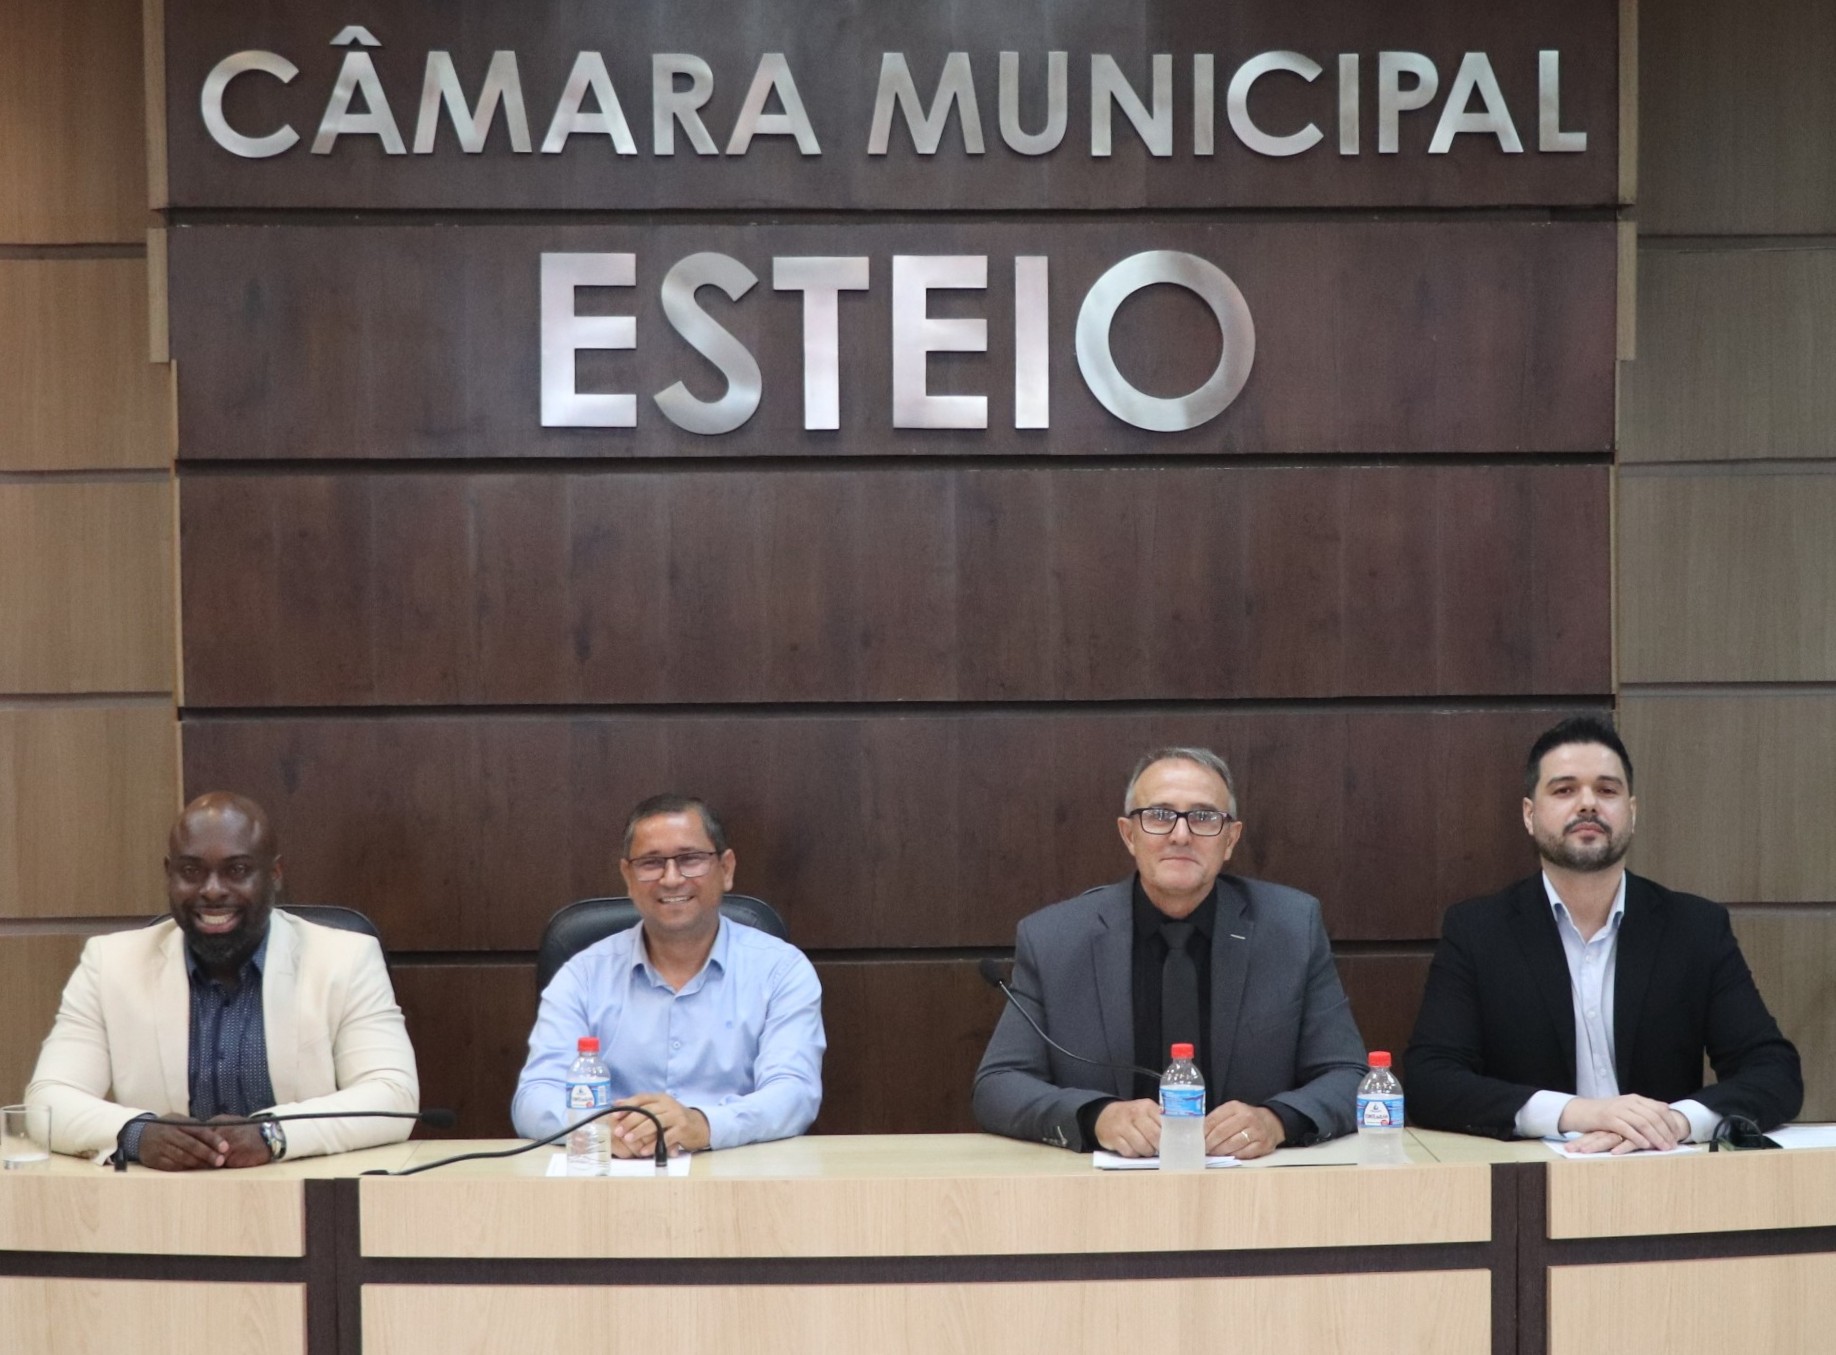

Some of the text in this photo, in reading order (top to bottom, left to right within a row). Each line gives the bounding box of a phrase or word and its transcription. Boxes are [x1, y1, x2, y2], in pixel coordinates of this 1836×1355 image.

[200, 25, 1588, 158] CÂMARA MUNICIPAL
[540, 250, 1256, 435] ESTEIO
